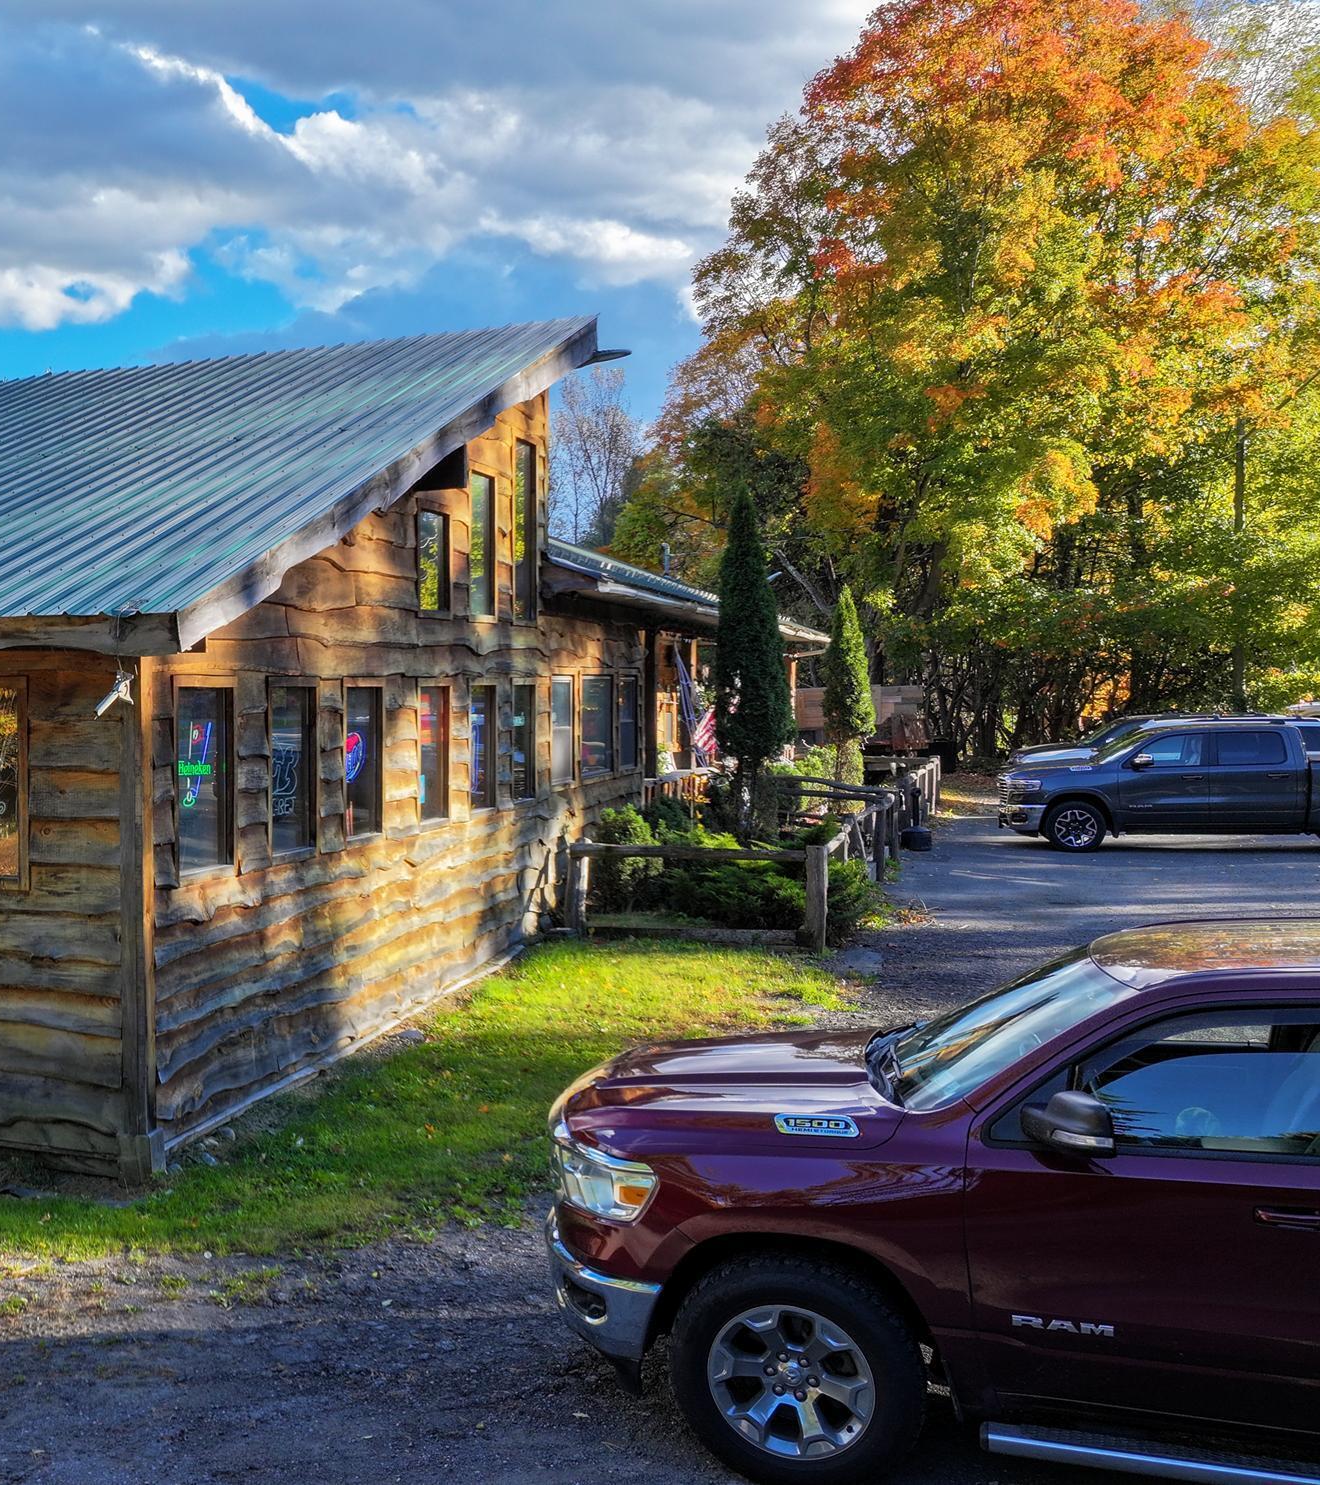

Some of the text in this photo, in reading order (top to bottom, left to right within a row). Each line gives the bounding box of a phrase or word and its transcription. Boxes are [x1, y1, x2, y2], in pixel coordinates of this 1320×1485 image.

[178, 760, 211, 776] Heineken
[787, 1119, 845, 1129] 1500
[1011, 1314, 1114, 1337] RAM
